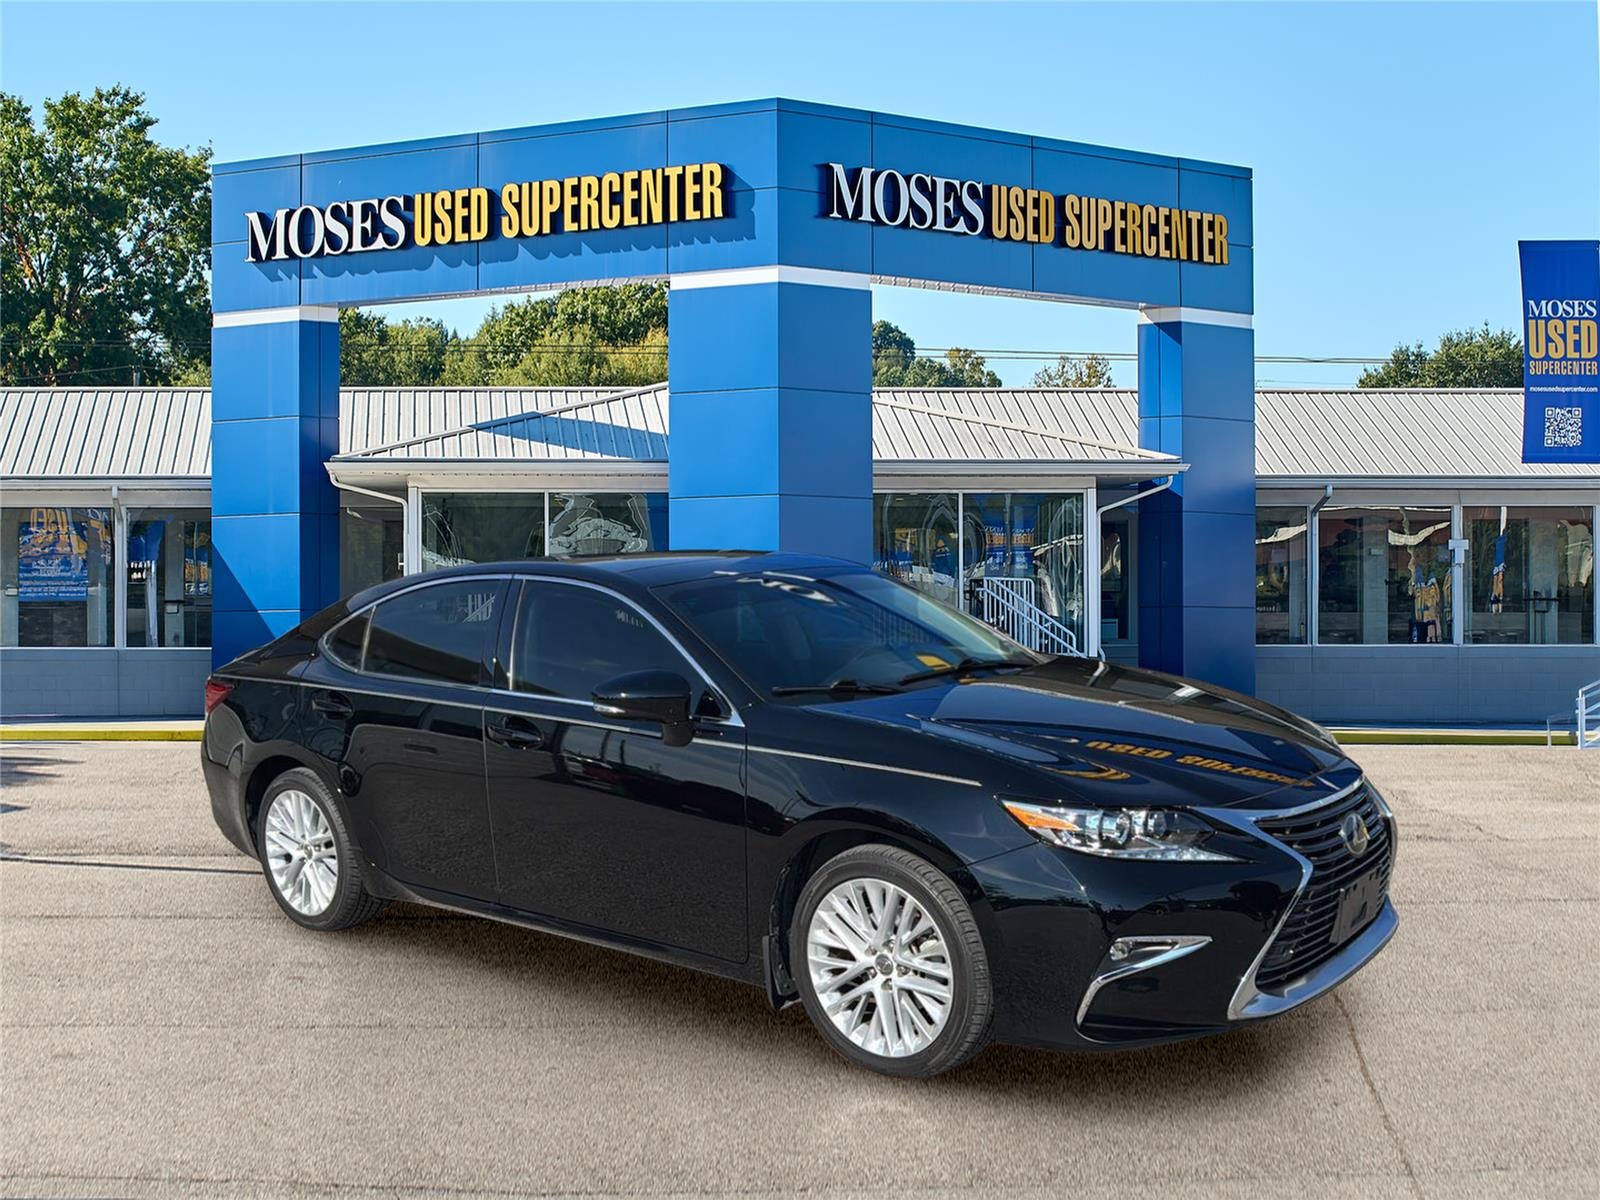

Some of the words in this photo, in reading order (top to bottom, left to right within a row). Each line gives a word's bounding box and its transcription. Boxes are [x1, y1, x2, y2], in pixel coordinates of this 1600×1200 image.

[244, 195, 407, 263] MOSES
[413, 186, 489, 247] USED
[500, 162, 723, 239] SUPERCENTER
[828, 162, 985, 236] MOSES
[990, 184, 1055, 244] USED
[1064, 193, 1229, 265] SUPERCENTER
[1527, 299, 1597, 318] MOSES
[1528, 319, 1598, 359] USED
[1529, 361, 1598, 375] SUPERCENTER
